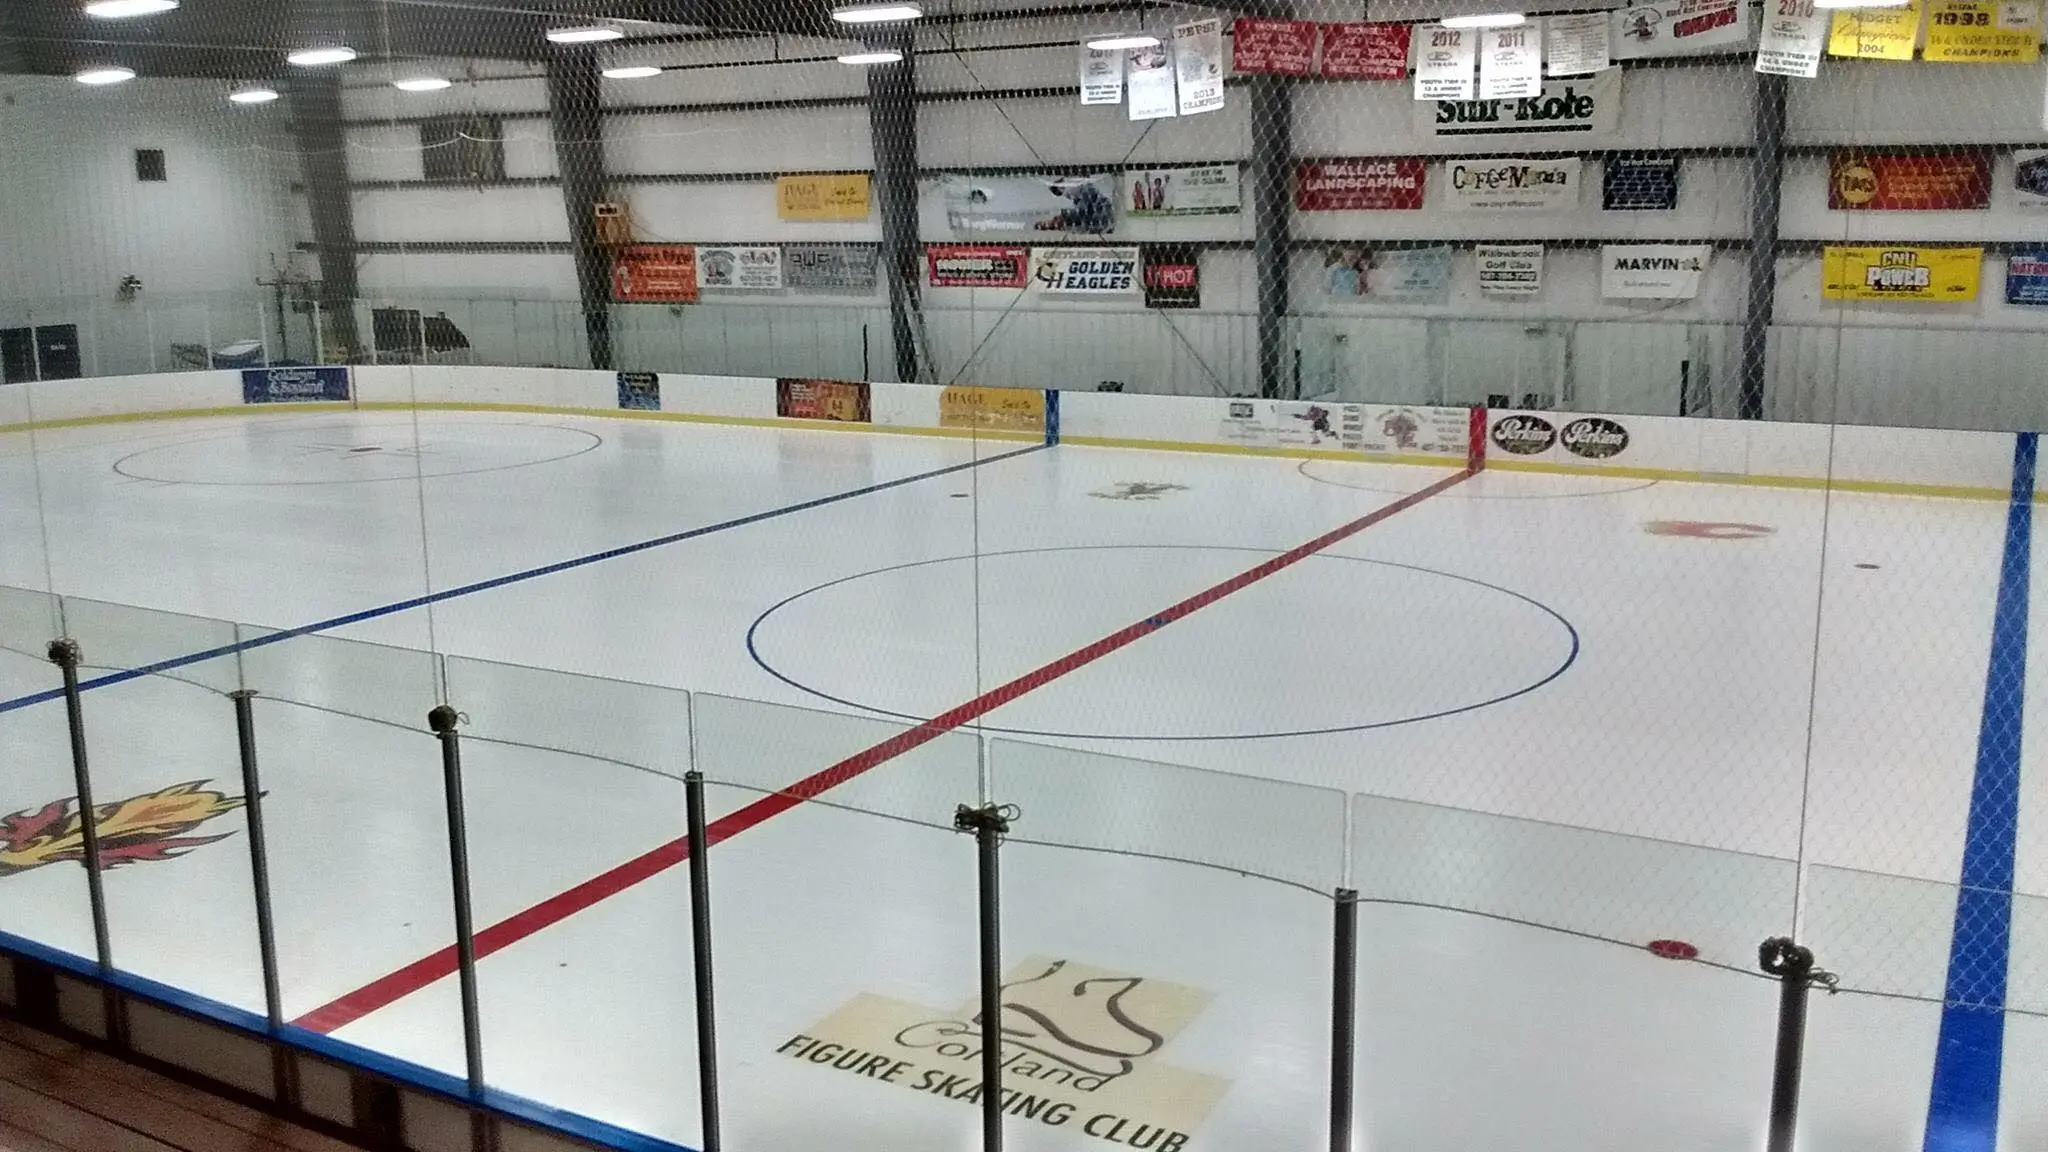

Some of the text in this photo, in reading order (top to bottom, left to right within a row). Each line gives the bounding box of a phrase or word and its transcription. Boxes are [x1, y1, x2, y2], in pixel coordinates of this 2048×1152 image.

[1933, 12, 1989, 26] 1998
[1431, 31, 1461, 47] 2012
[1497, 32, 1526, 48] 2011
[1324, 163, 1397, 176] WALLACE
[1306, 176, 1416, 191] LANDSCAPING
[1069, 262, 1135, 274] GOLDEN
[1486, 261, 1506, 269] Golf
[1614, 258, 1679, 270] MARVIN
[1065, 276, 1131, 289] EAGLES
[1163, 269, 1195, 285] HOT
[1496, 419, 1553, 441] Perkins
[1564, 422, 1625, 446] Perkins
[895, 1019, 1116, 1093] Corland
[776, 1034, 915, 1083] FIGURE
[1083, 1113, 1191, 1152] CLUB
